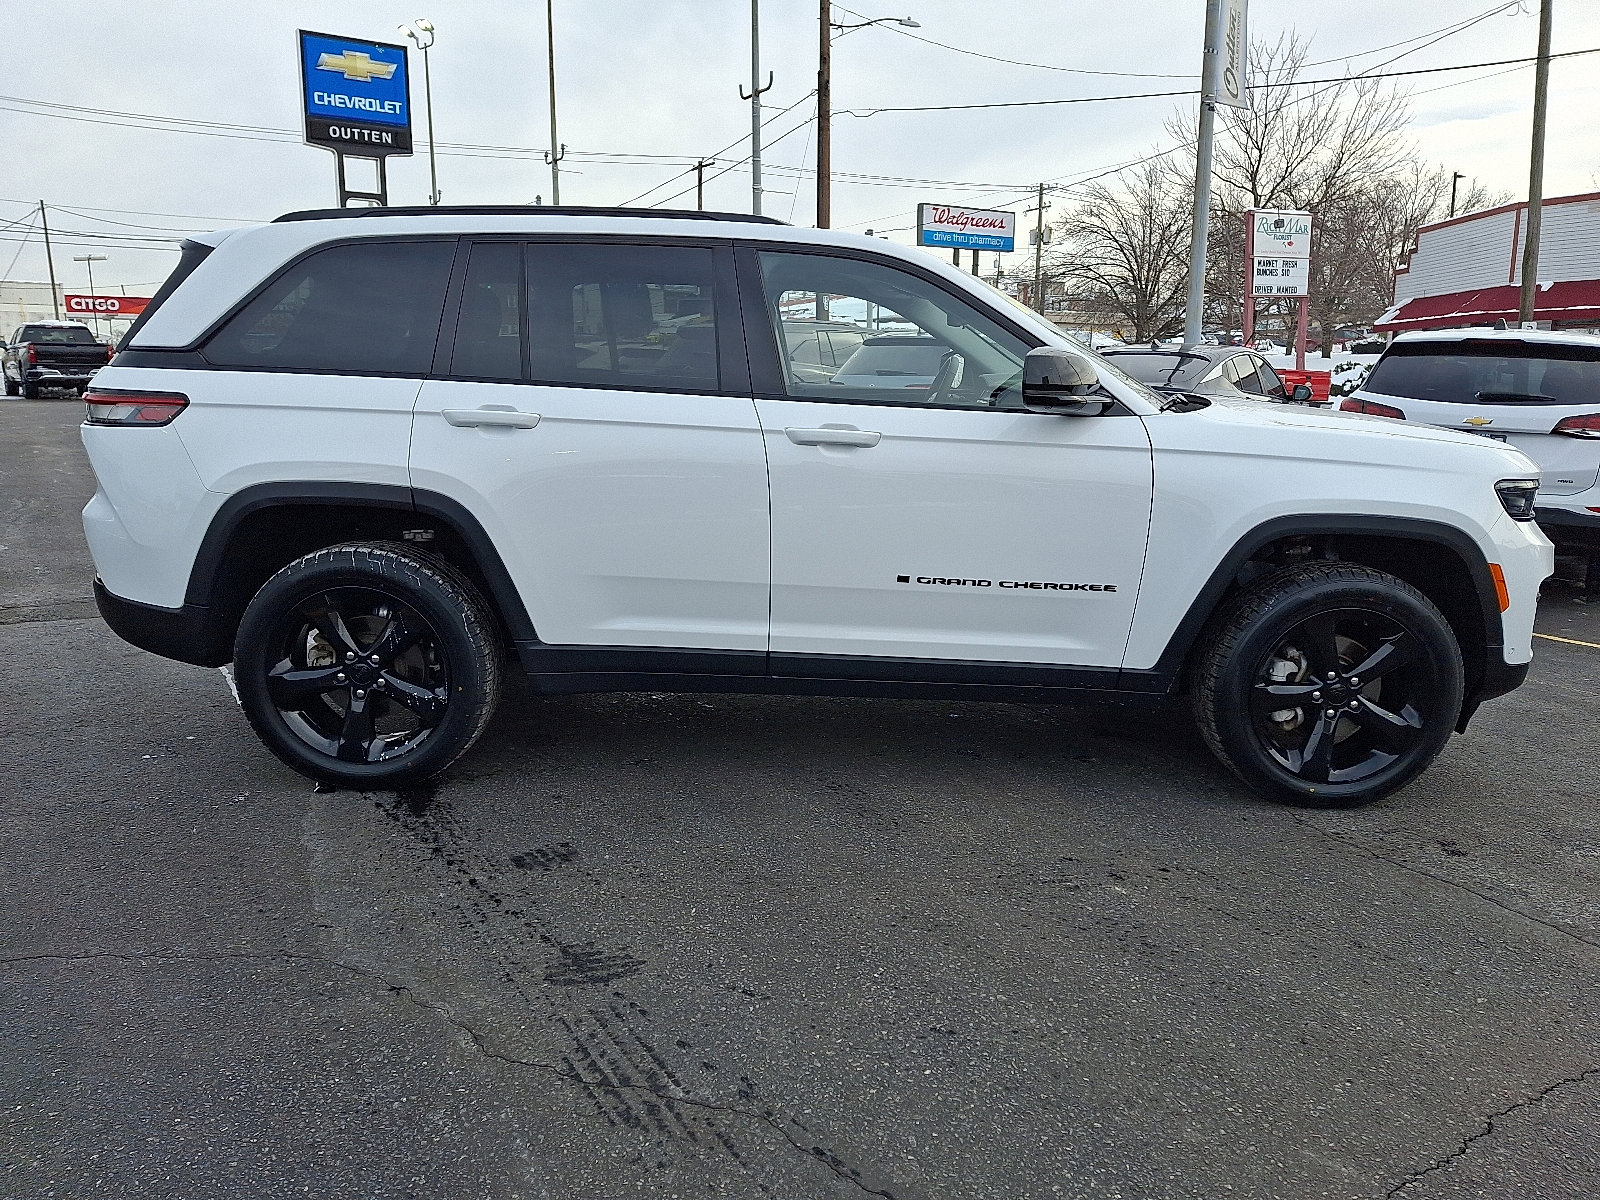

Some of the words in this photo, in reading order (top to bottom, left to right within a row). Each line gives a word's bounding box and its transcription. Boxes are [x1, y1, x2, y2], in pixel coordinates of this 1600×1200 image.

[313, 91, 402, 115] CHEVROLET
[329, 125, 392, 144] OUTTEN
[932, 206, 1006, 232] Walgreens
[933, 231, 952, 242] drive
[953, 233, 968, 243] thru
[969, 235, 1005, 247] pharmacy
[1257, 259, 1278, 268] MARKET
[1282, 260, 1298, 269] FRESH
[1256, 268, 1278, 277] BUNCHES
[1254, 285, 1273, 294] DRIVER
[1276, 286, 1298, 294] WANTED
[70, 297, 120, 311] CITGO
[916, 576, 992, 588] GRAND
[998, 580, 1117, 593] CHEROKEE
